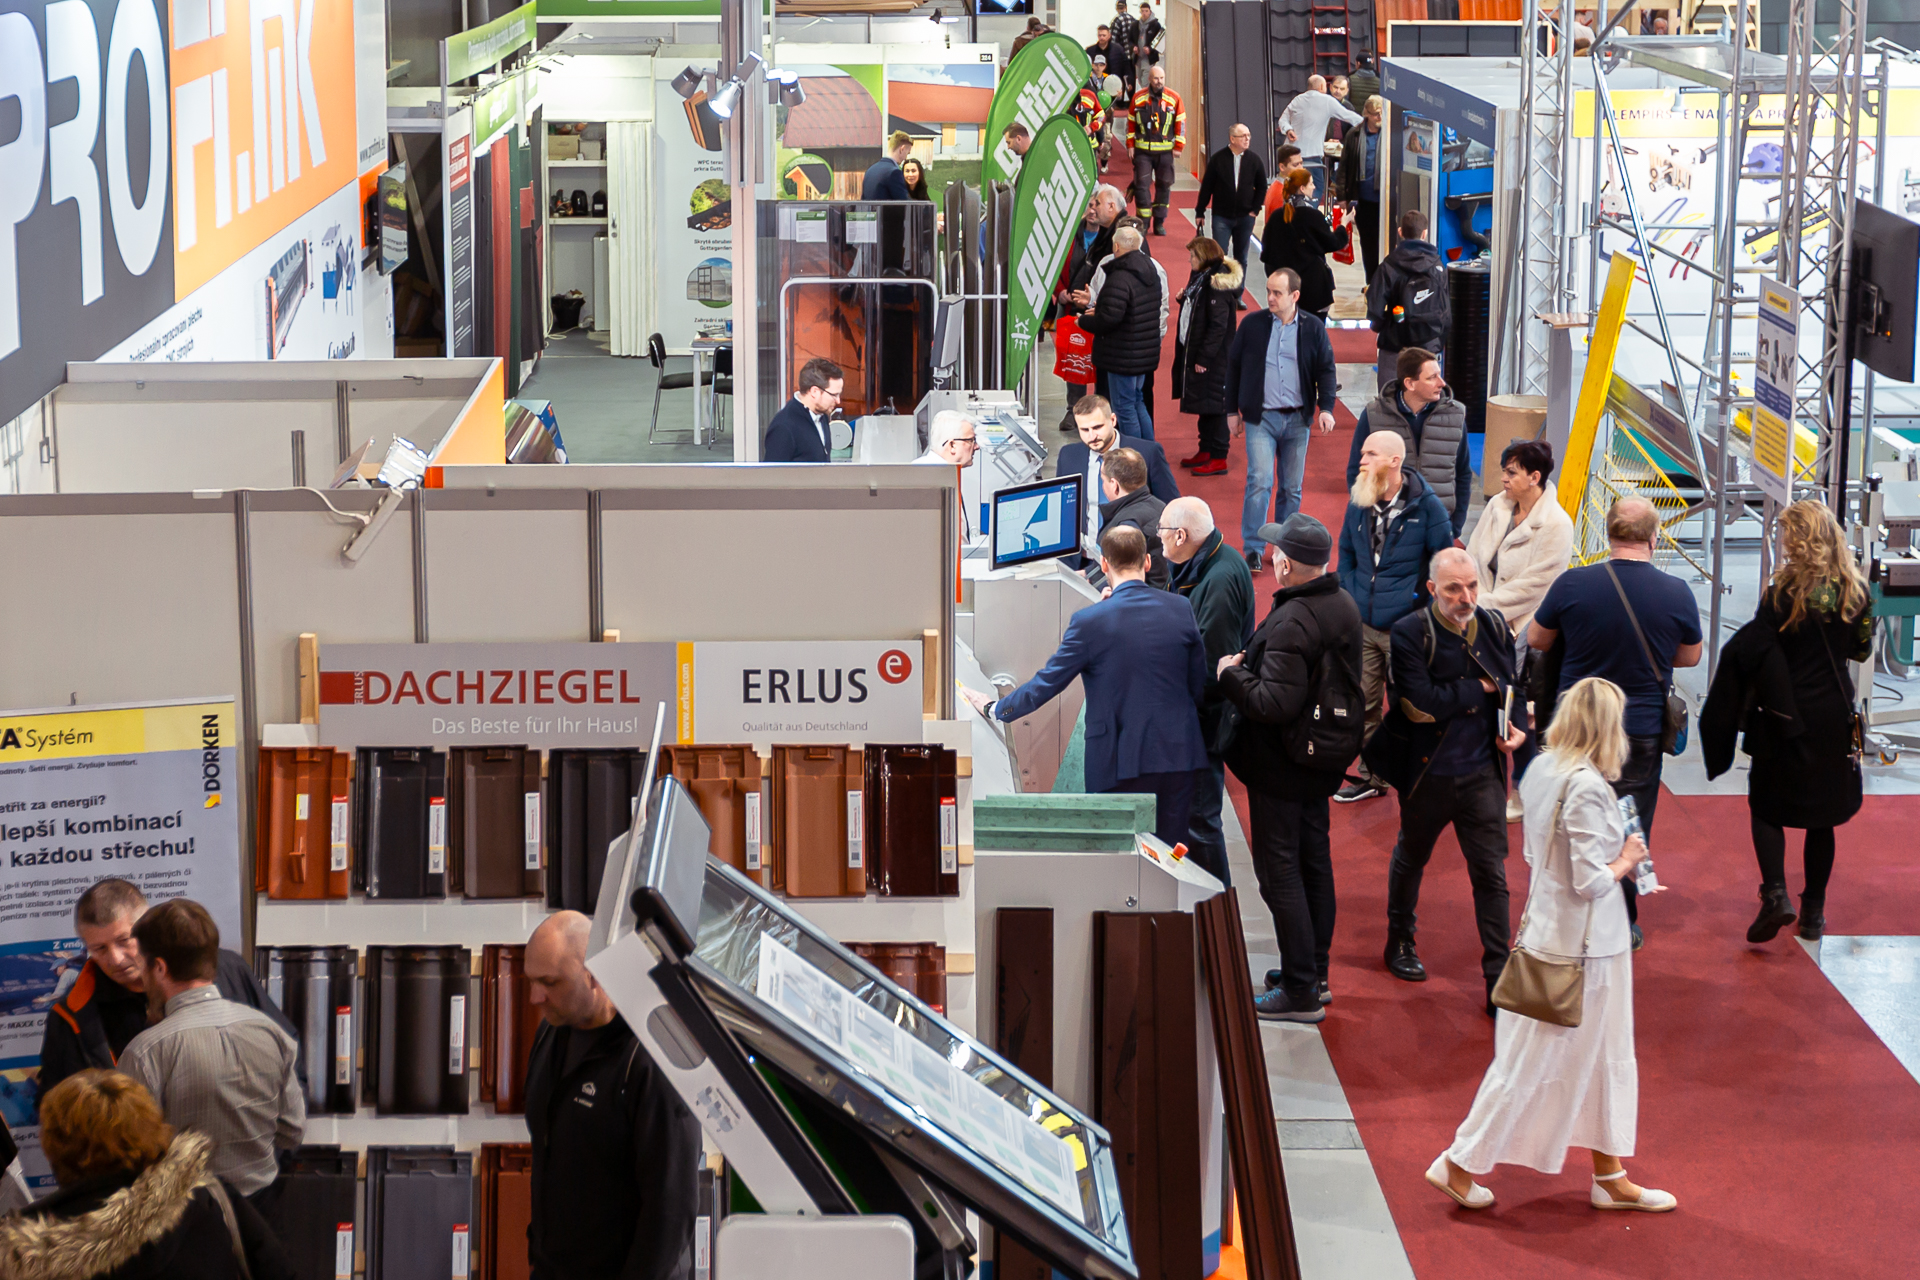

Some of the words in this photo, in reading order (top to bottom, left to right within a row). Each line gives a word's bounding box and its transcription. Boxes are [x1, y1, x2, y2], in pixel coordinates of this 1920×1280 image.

[1053, 43, 1083, 84] www.gutta.cz
[1062, 128, 1091, 186] www.gutta.cz
[363, 668, 641, 706] DACHZIEGEL
[682, 663, 690, 741] www.erlus.com
[742, 668, 869, 705] ERLUS
[25, 728, 93, 752] Systém
[432, 717, 465, 735] Das
[471, 717, 521, 735] Beste
[526, 716, 552, 734] für
[557, 717, 582, 734] Ihr
[587, 716, 639, 734] Haus!
[742, 721, 783, 733] Qualität
[785, 723, 803, 732] aus
[806, 721, 868, 732] Deutschland
[107, 759, 138, 767] komfort.
[202, 714, 220, 792] DÖRKEN
[30, 802, 46, 810] za
[51, 795, 106, 809] energii?
[1, 819, 55, 842] lepší
[64, 810, 183, 836] kombinací
[10, 847, 93, 868] každou
[101, 837, 196, 861] střechu!
